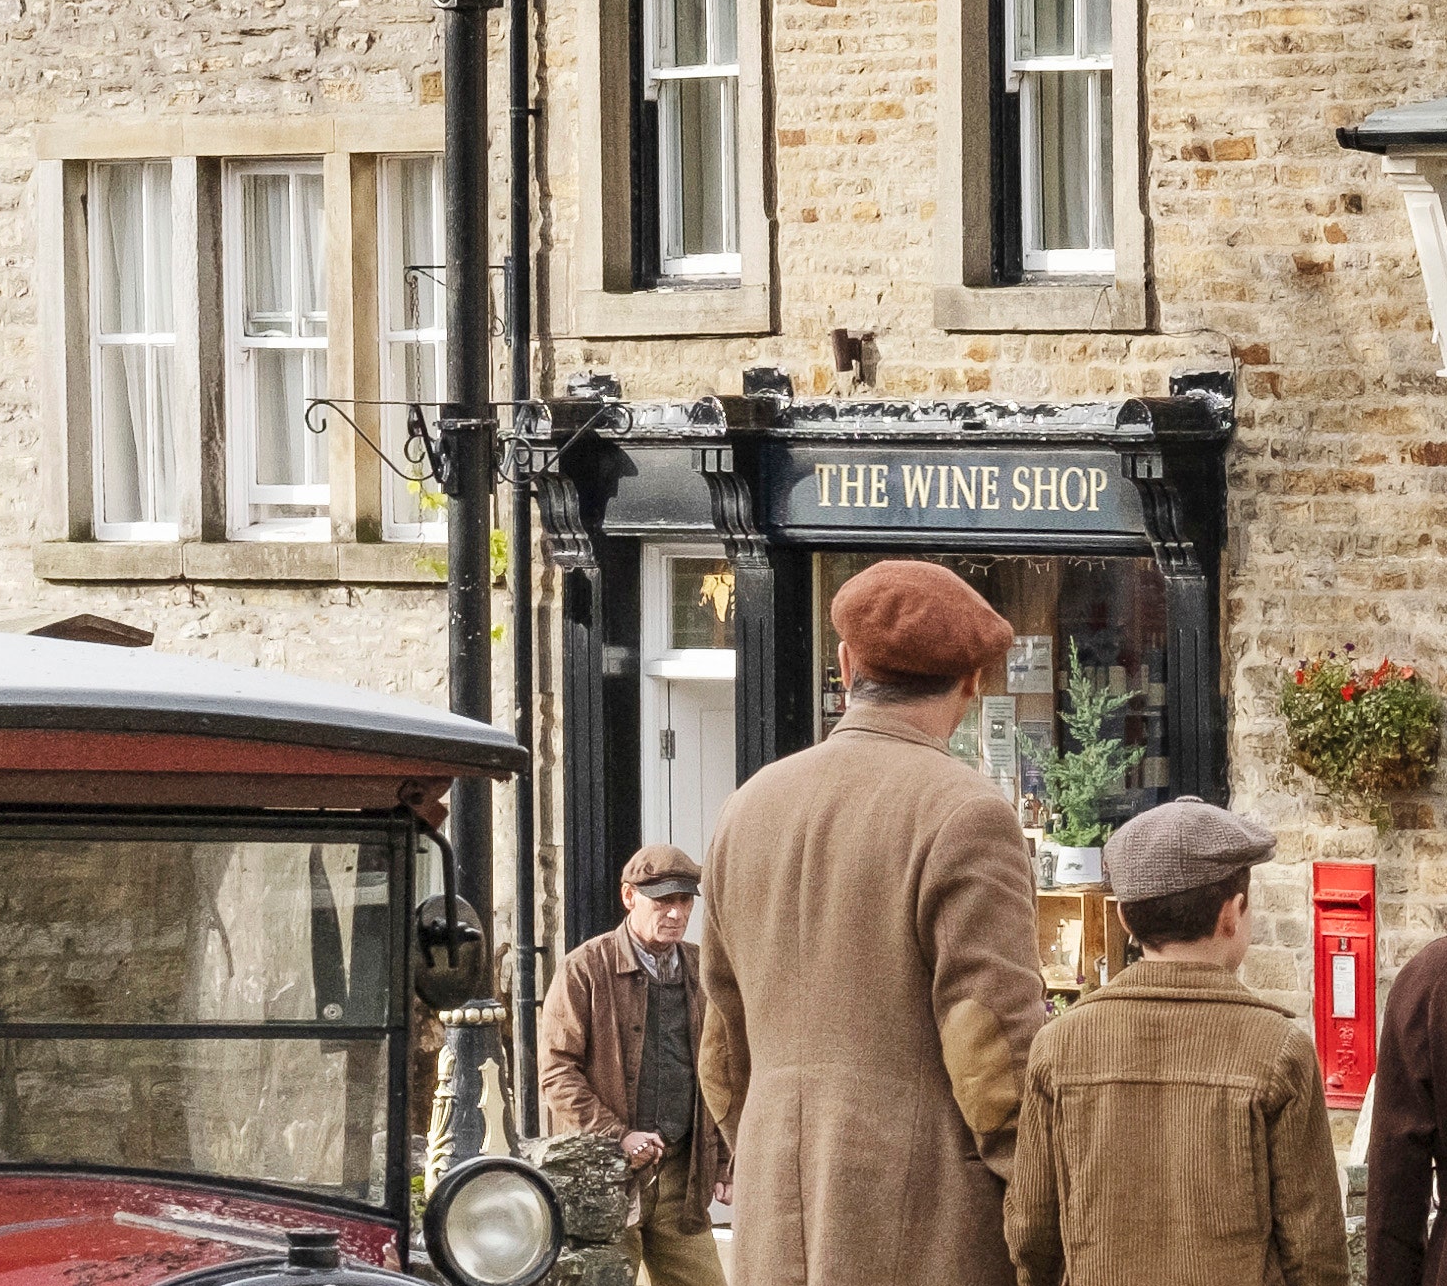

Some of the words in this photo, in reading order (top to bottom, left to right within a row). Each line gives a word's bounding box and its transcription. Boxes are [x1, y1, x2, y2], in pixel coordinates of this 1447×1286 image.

[814, 463, 890, 509] THE
[900, 464, 1000, 510] WINE
[1011, 465, 1108, 512] SHOP
